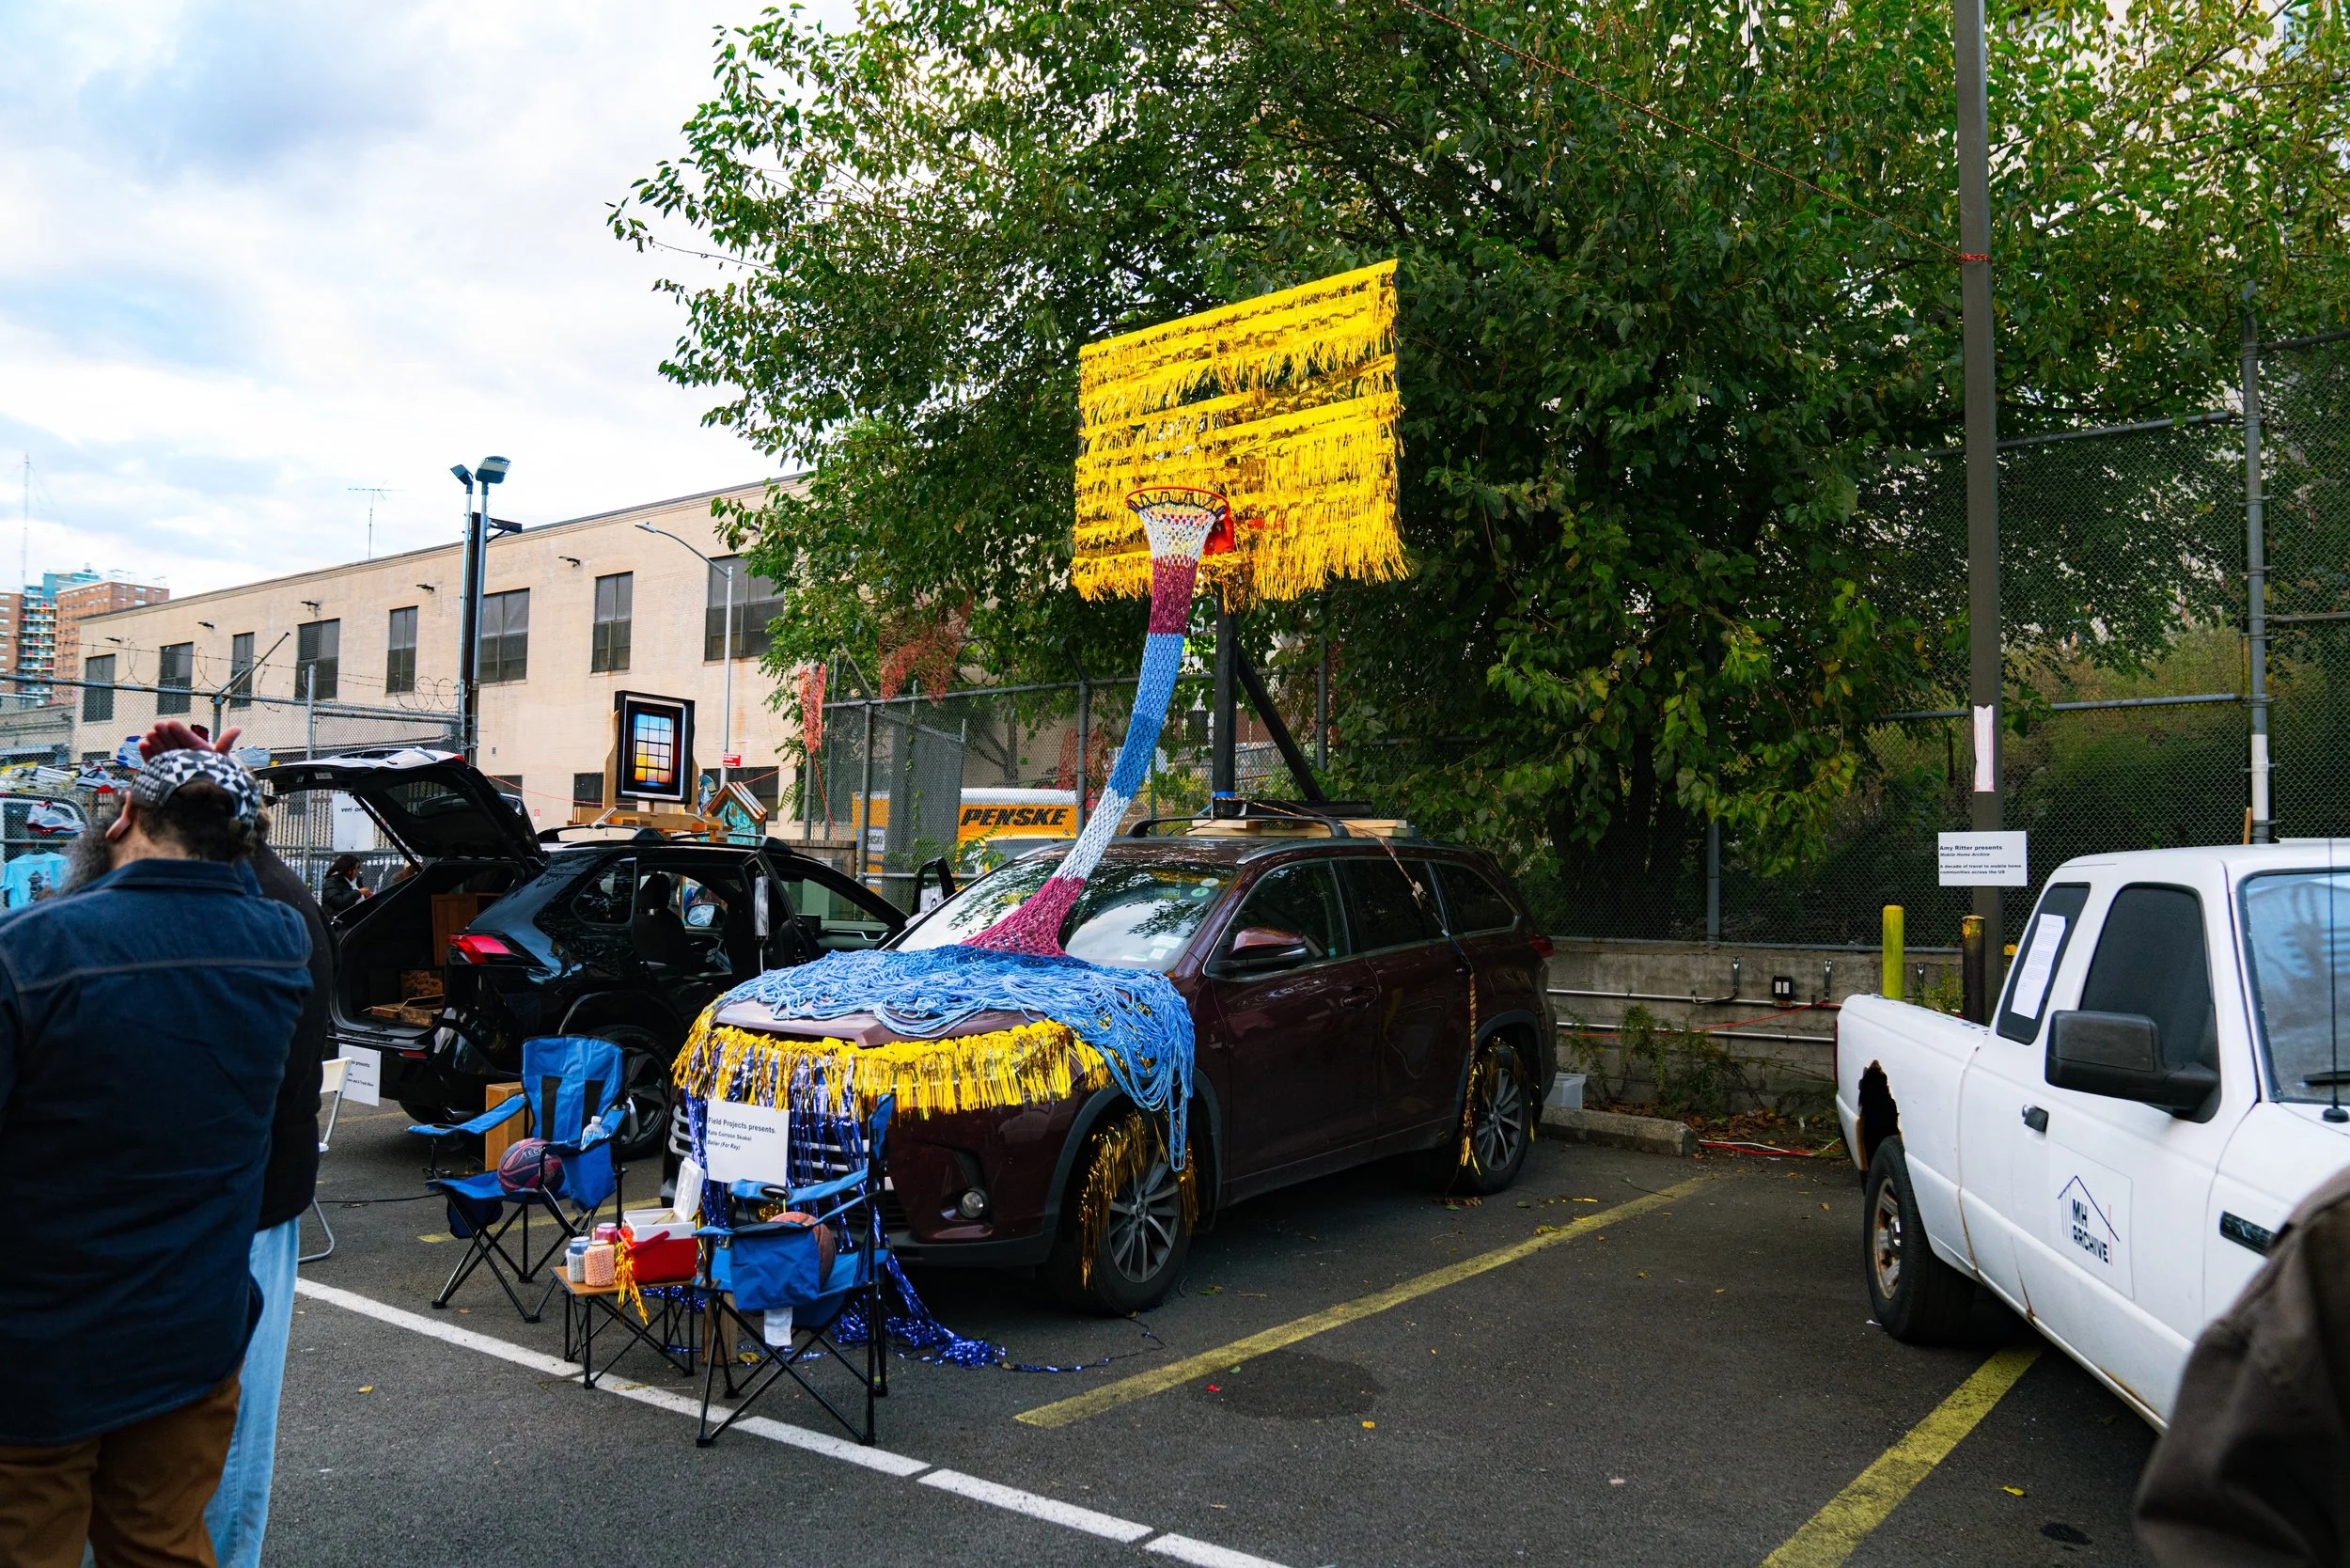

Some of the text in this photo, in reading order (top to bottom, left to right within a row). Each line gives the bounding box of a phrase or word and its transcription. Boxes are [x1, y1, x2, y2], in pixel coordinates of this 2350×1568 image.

[961, 808, 1069, 826] PENSKE
[709, 1117, 776, 1133] Field Projects presents
[2072, 1198, 2087, 1228] MH
[2073, 1224, 2108, 1263] ARCHIVE
